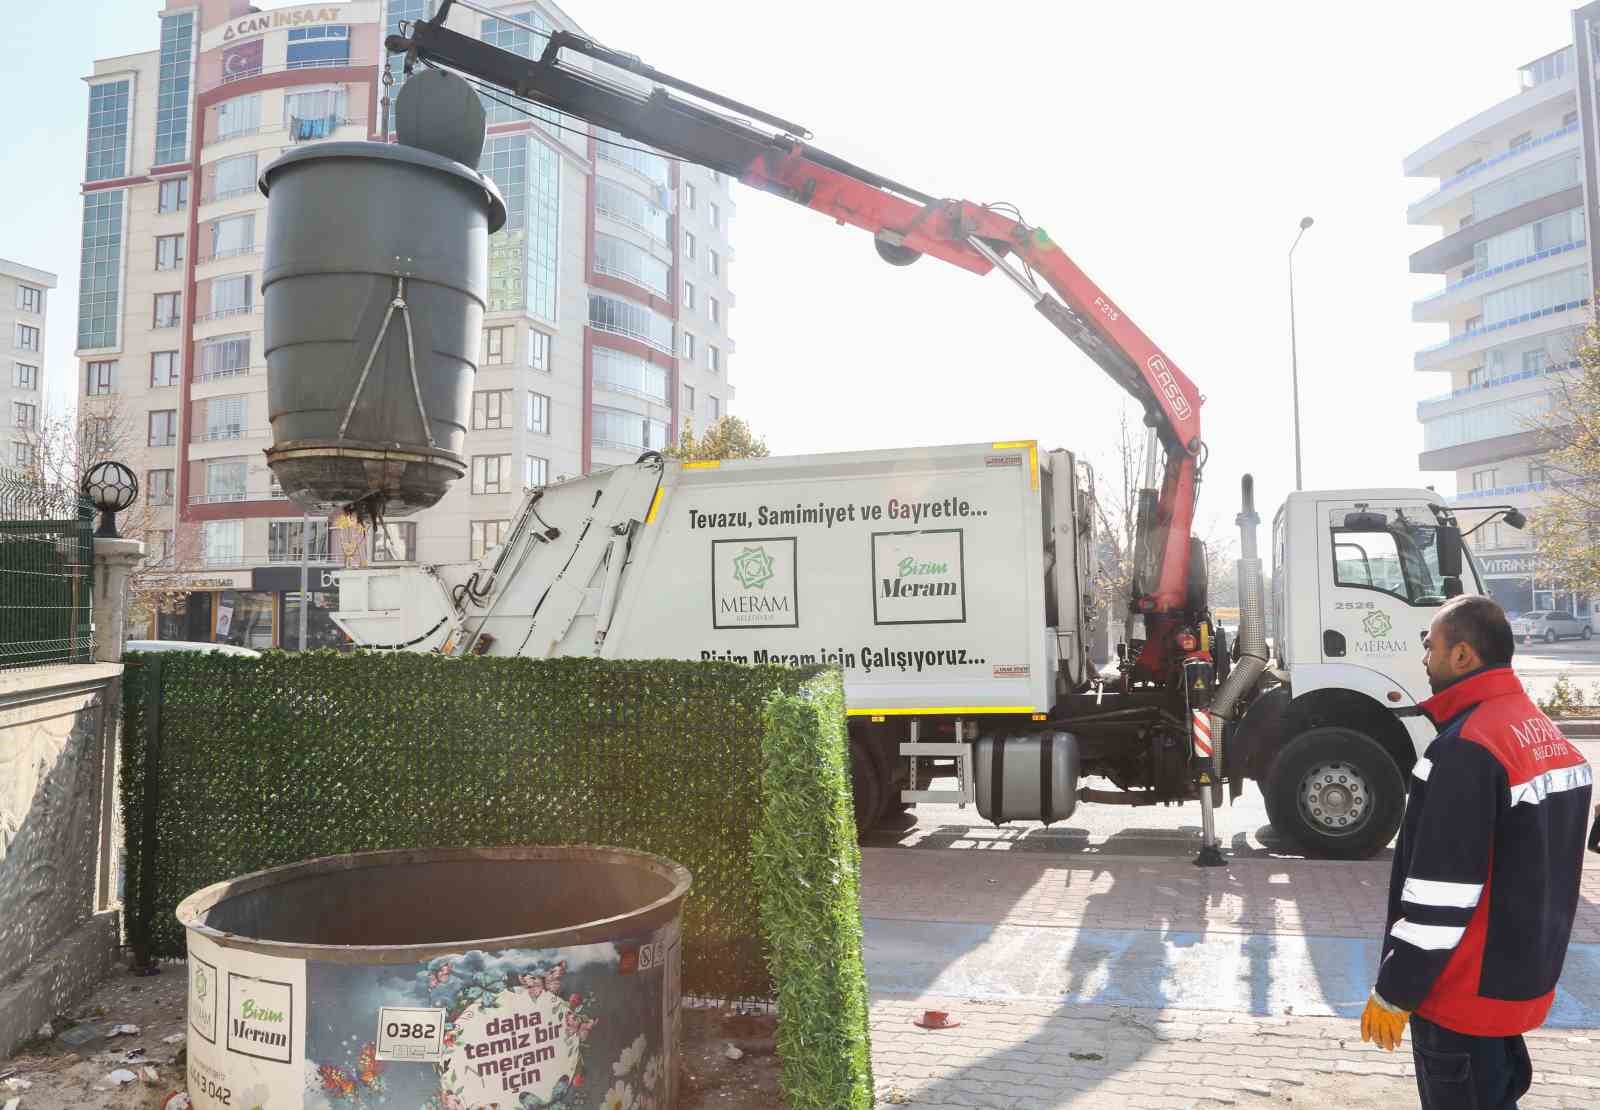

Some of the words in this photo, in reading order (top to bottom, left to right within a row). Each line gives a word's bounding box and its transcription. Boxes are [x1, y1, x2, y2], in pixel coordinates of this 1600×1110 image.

[238, 16, 270, 34] CAN
[1150, 358, 1189, 418] FASSI
[688, 508, 753, 529] Tevazu,
[758, 502, 855, 528] Samimiyet
[861, 503, 882, 520] ve
[888, 496, 988, 524] Gayretle...
[897, 557, 948, 577] Bizim
[881, 578, 957, 598] Meram
[720, 595, 789, 613] MERAM
[1352, 639, 1408, 652] MERAM
[861, 646, 986, 673] Çalışıyoruz...
[240, 999, 284, 1023] Bizim
[486, 1011, 542, 1037] daha
[231, 1018, 287, 1047] Meram
[386, 1022, 436, 1039] 0382
[464, 1033, 530, 1060] temiz
[535, 1022, 563, 1043] bir
[477, 1044, 556, 1077] meram
[502, 1066, 542, 1093] için
